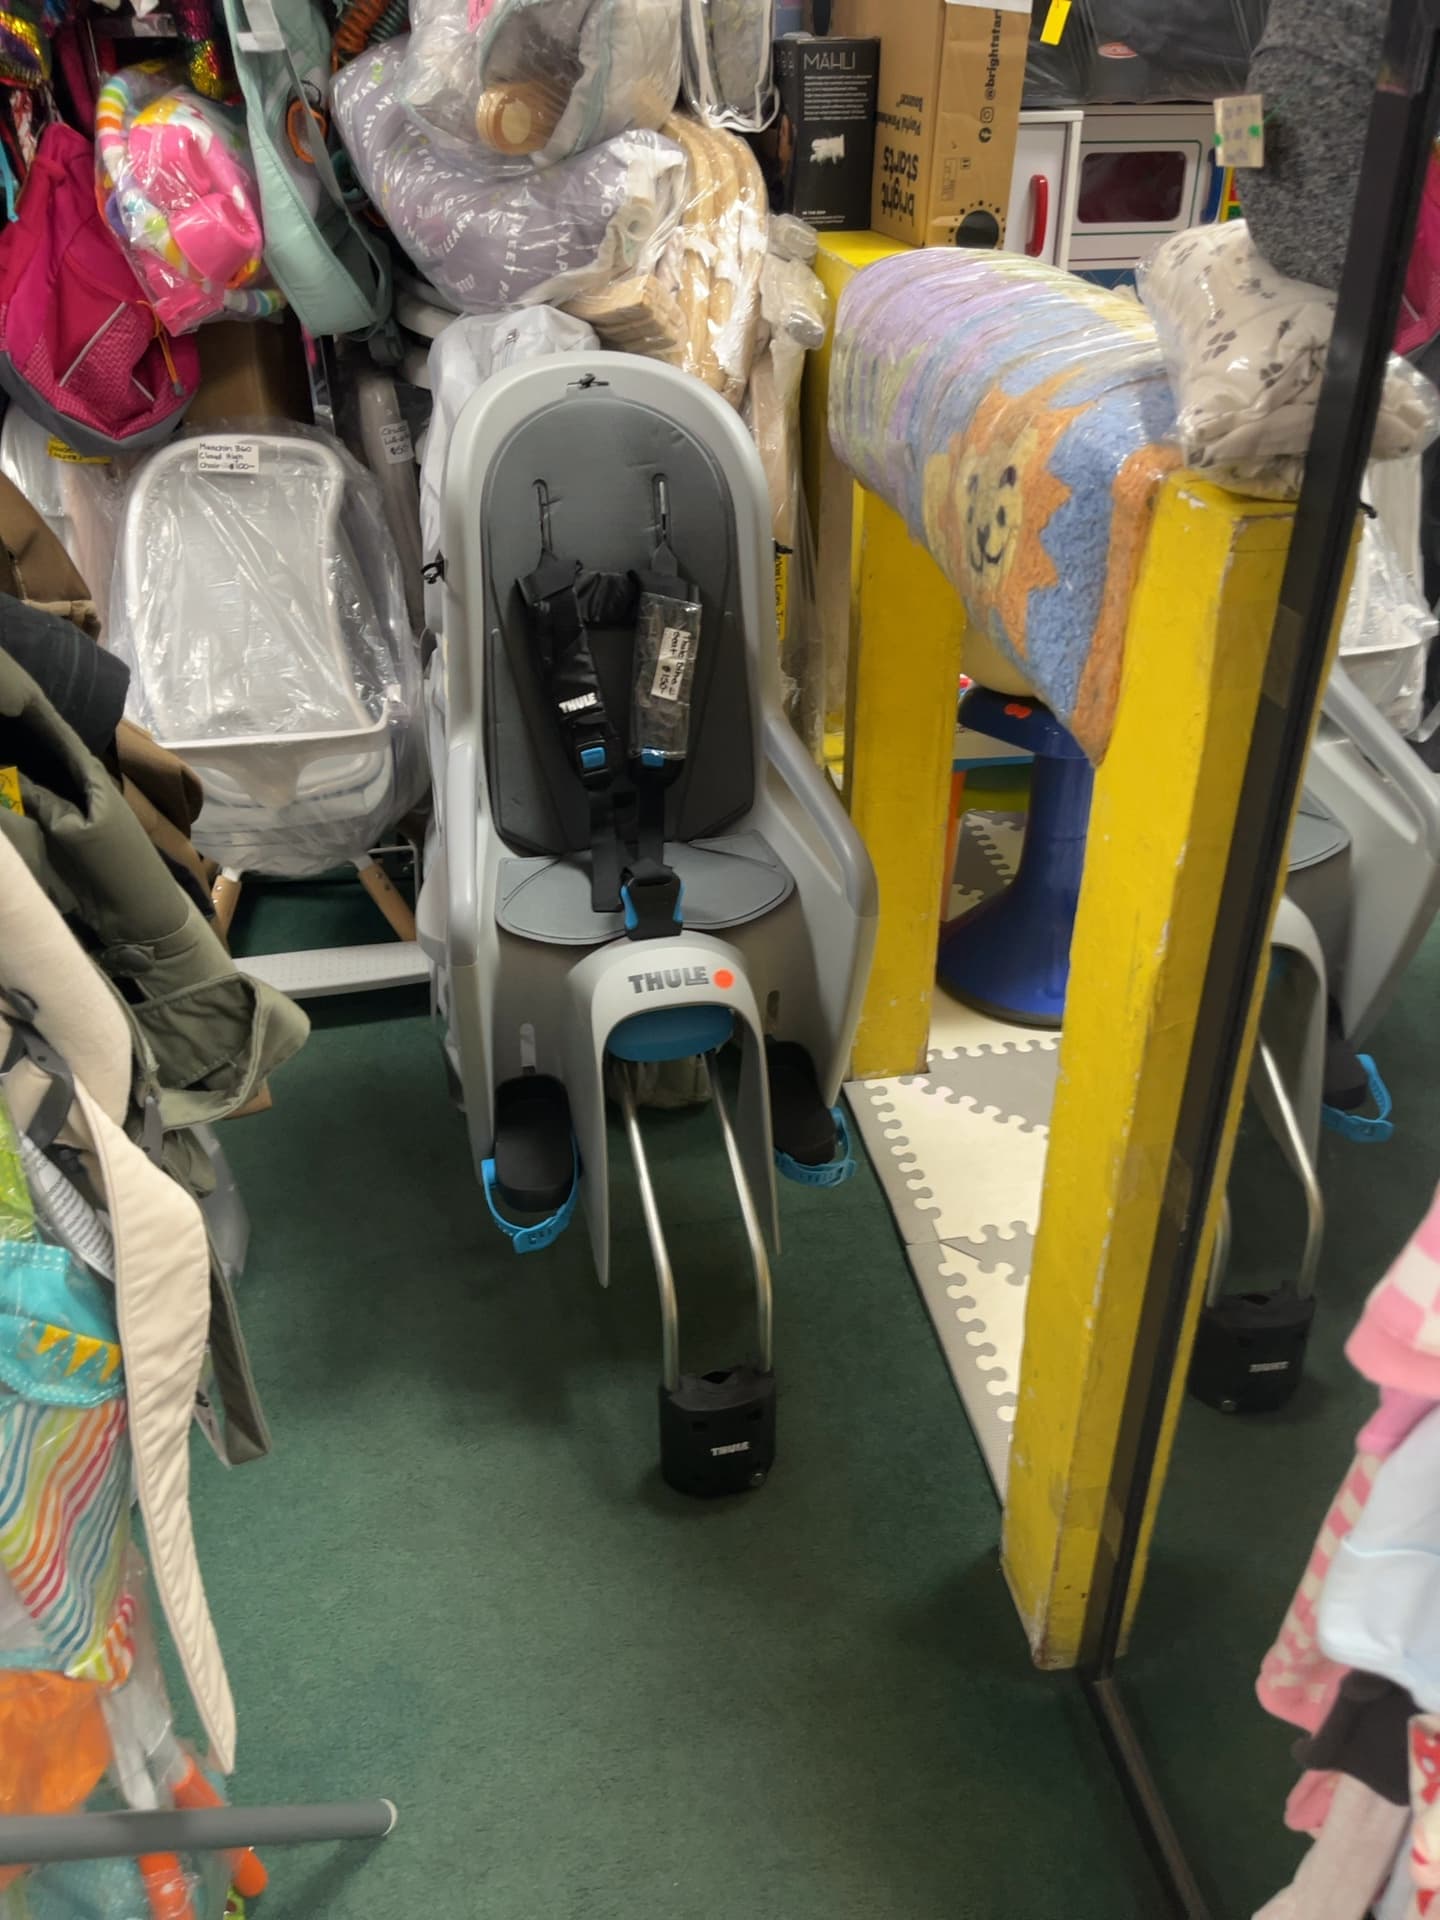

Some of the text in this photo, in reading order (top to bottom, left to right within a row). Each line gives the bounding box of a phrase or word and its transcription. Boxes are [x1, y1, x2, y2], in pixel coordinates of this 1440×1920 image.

[883, 145, 919, 187] starts
[881, 176, 916, 227] bright
[558, 692, 600, 714] THULE
[628, 965, 711, 995] THULE
[710, 1441, 750, 1457] THULE
